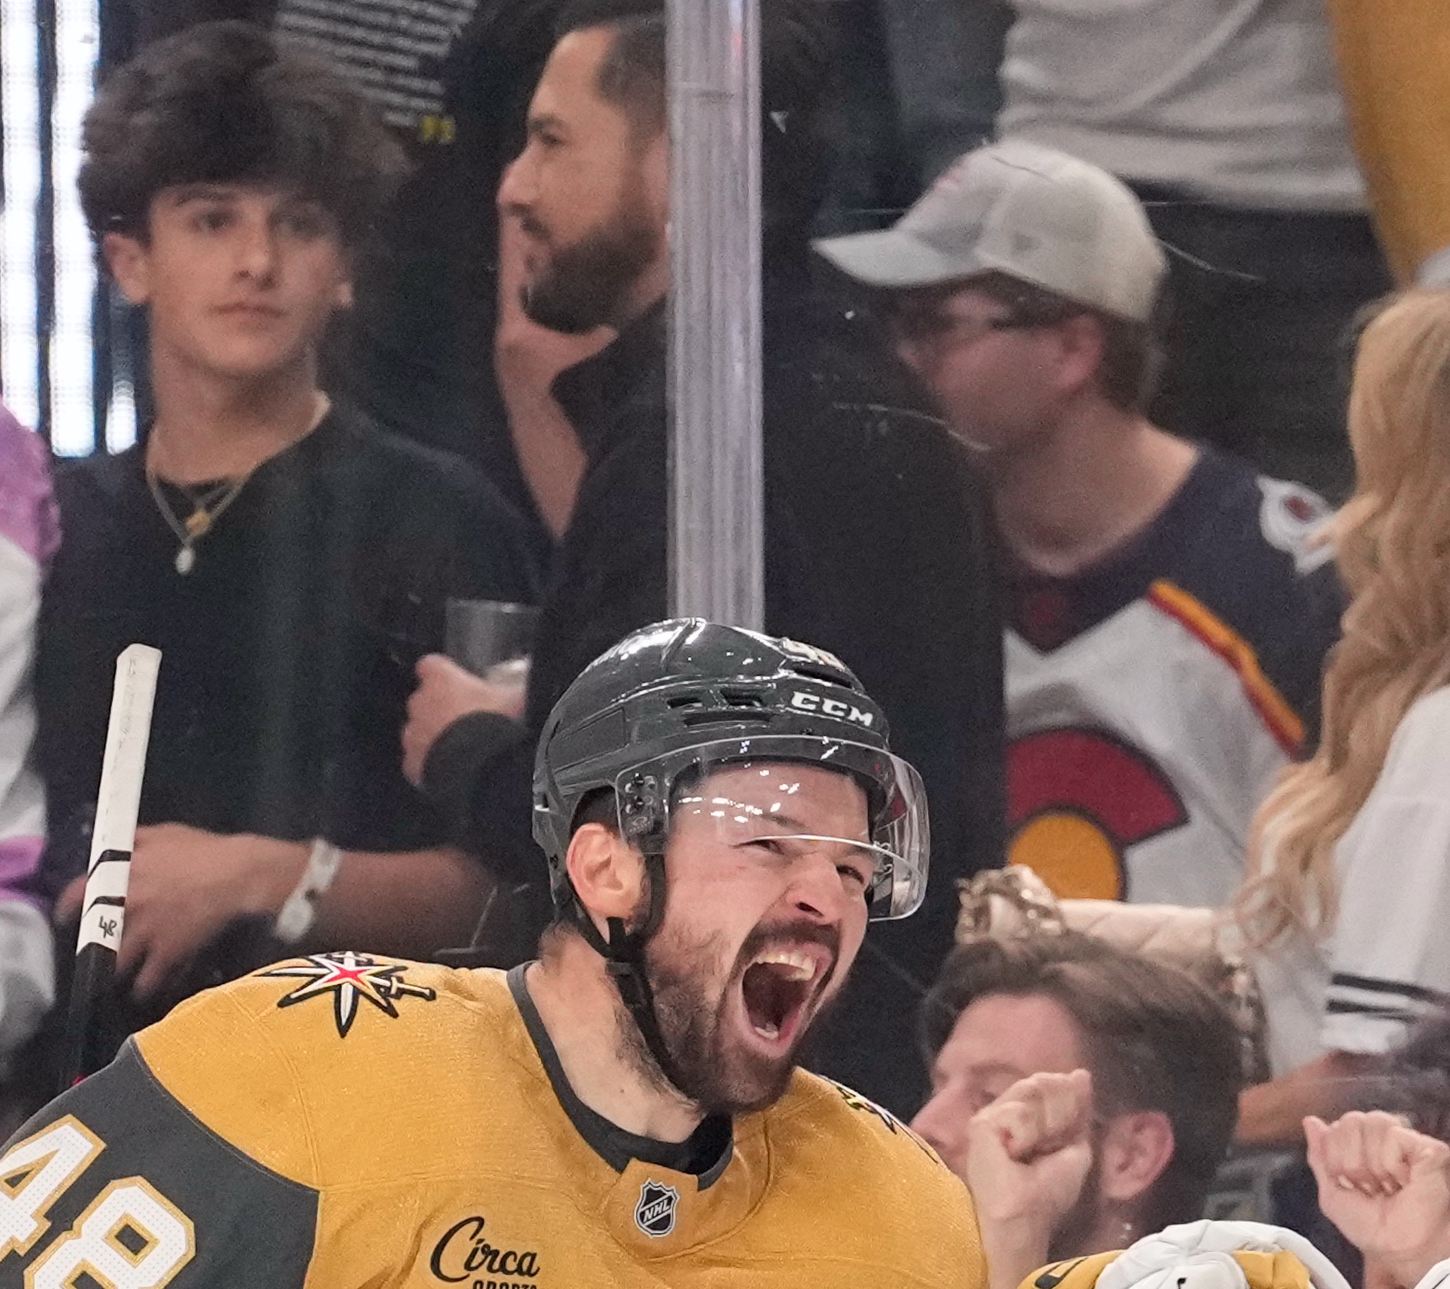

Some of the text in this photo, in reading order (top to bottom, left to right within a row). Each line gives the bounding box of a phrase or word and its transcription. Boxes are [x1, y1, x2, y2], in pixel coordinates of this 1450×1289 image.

[791, 691, 874, 727] CCM
[643, 1201, 671, 1224] NHL
[430, 1216, 541, 1283] Circa
